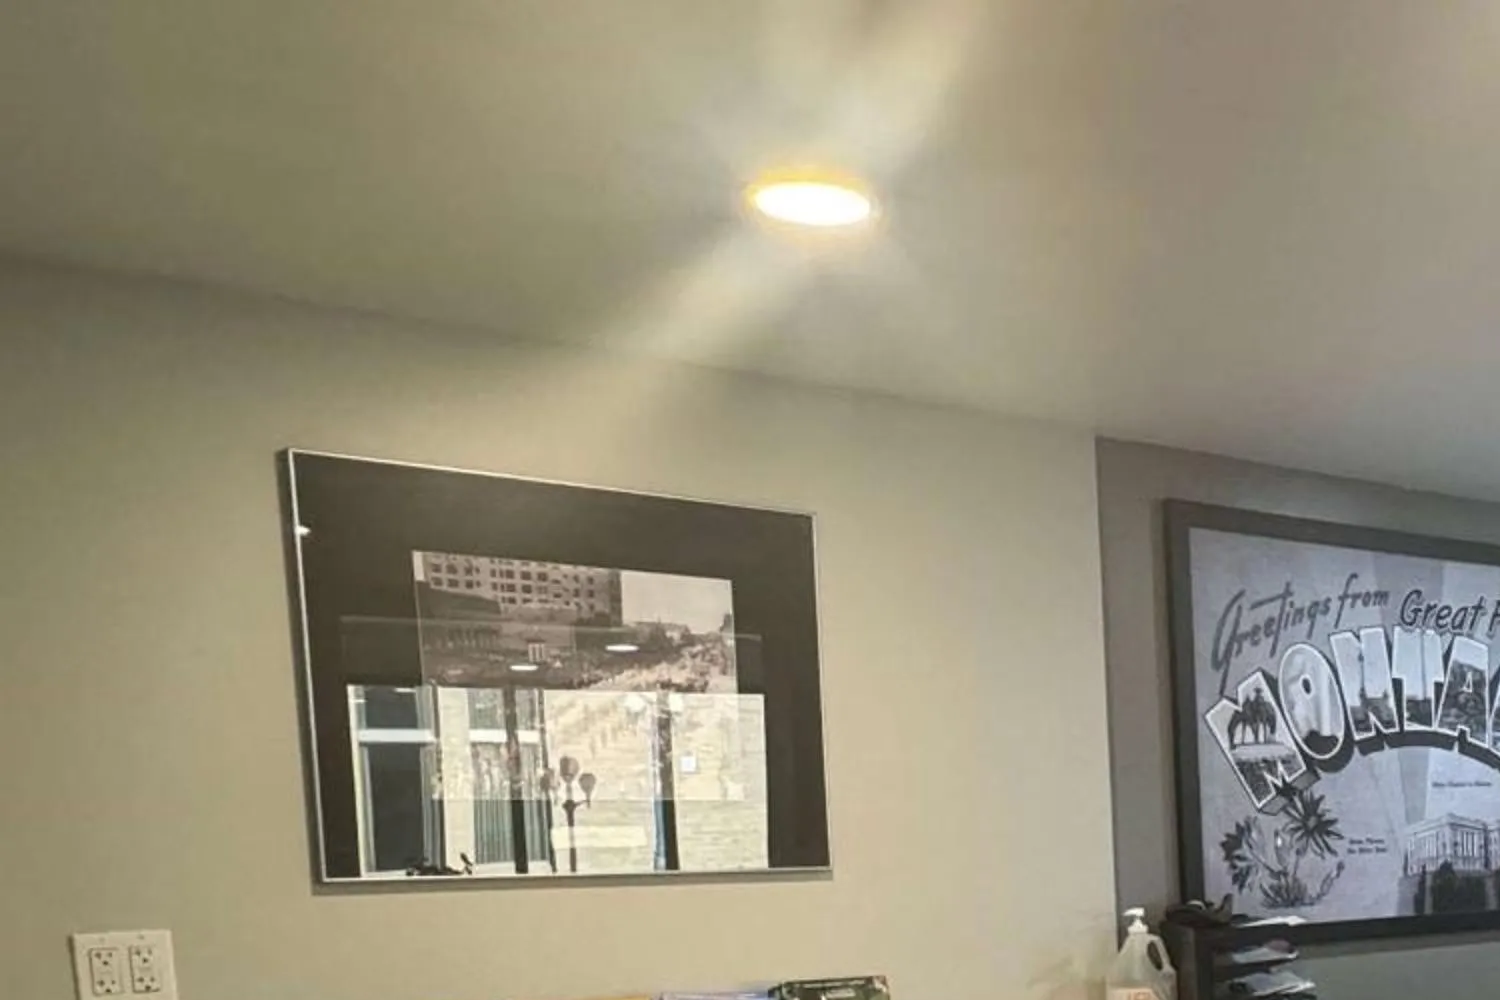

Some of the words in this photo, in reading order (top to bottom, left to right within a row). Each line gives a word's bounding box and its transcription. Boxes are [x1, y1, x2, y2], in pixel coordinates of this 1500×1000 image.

[1212, 581, 1330, 698] Greetings
[1334, 573, 1390, 630] from
[1400, 589, 1484, 633] Great
